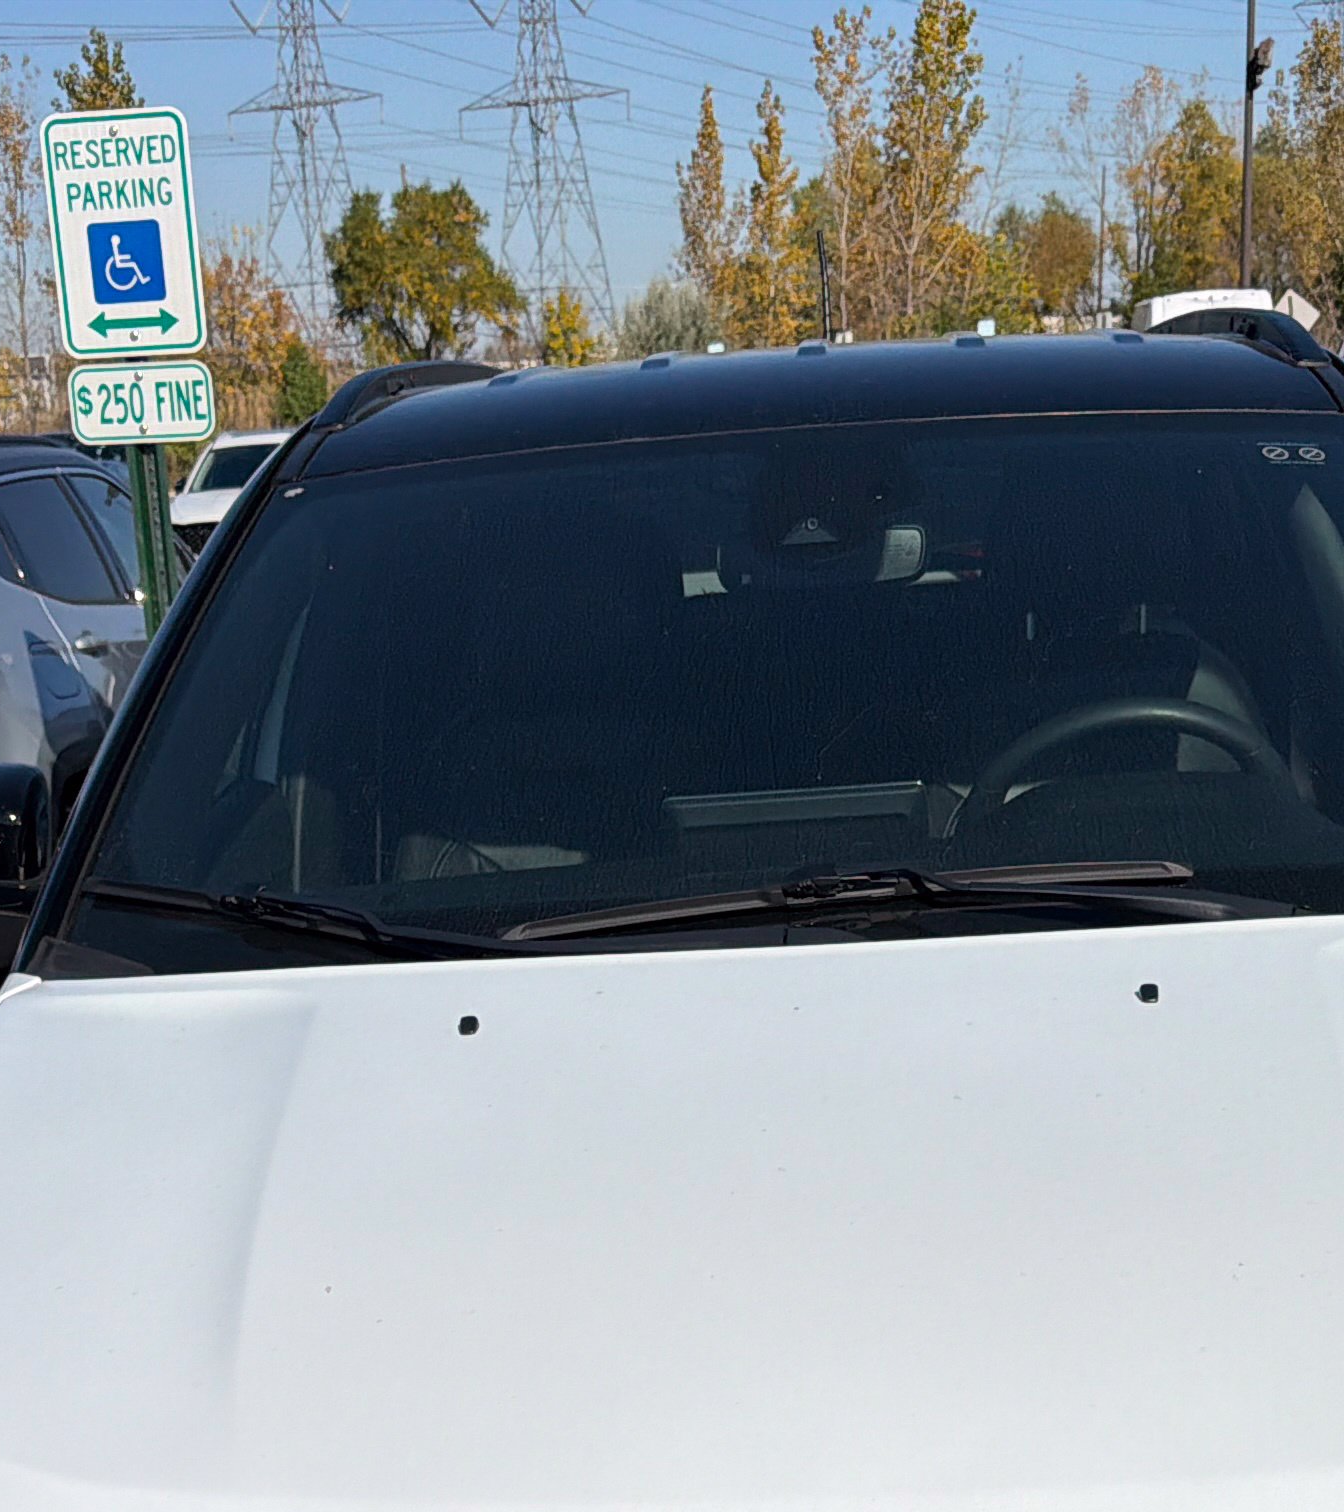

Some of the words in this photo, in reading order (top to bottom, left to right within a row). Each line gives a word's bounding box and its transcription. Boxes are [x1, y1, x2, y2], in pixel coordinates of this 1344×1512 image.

[53, 134, 176, 171] RESERVED
[66, 176, 173, 212] PARKING
[77, 382, 144, 425] $250
[154, 379, 207, 423] FINE
